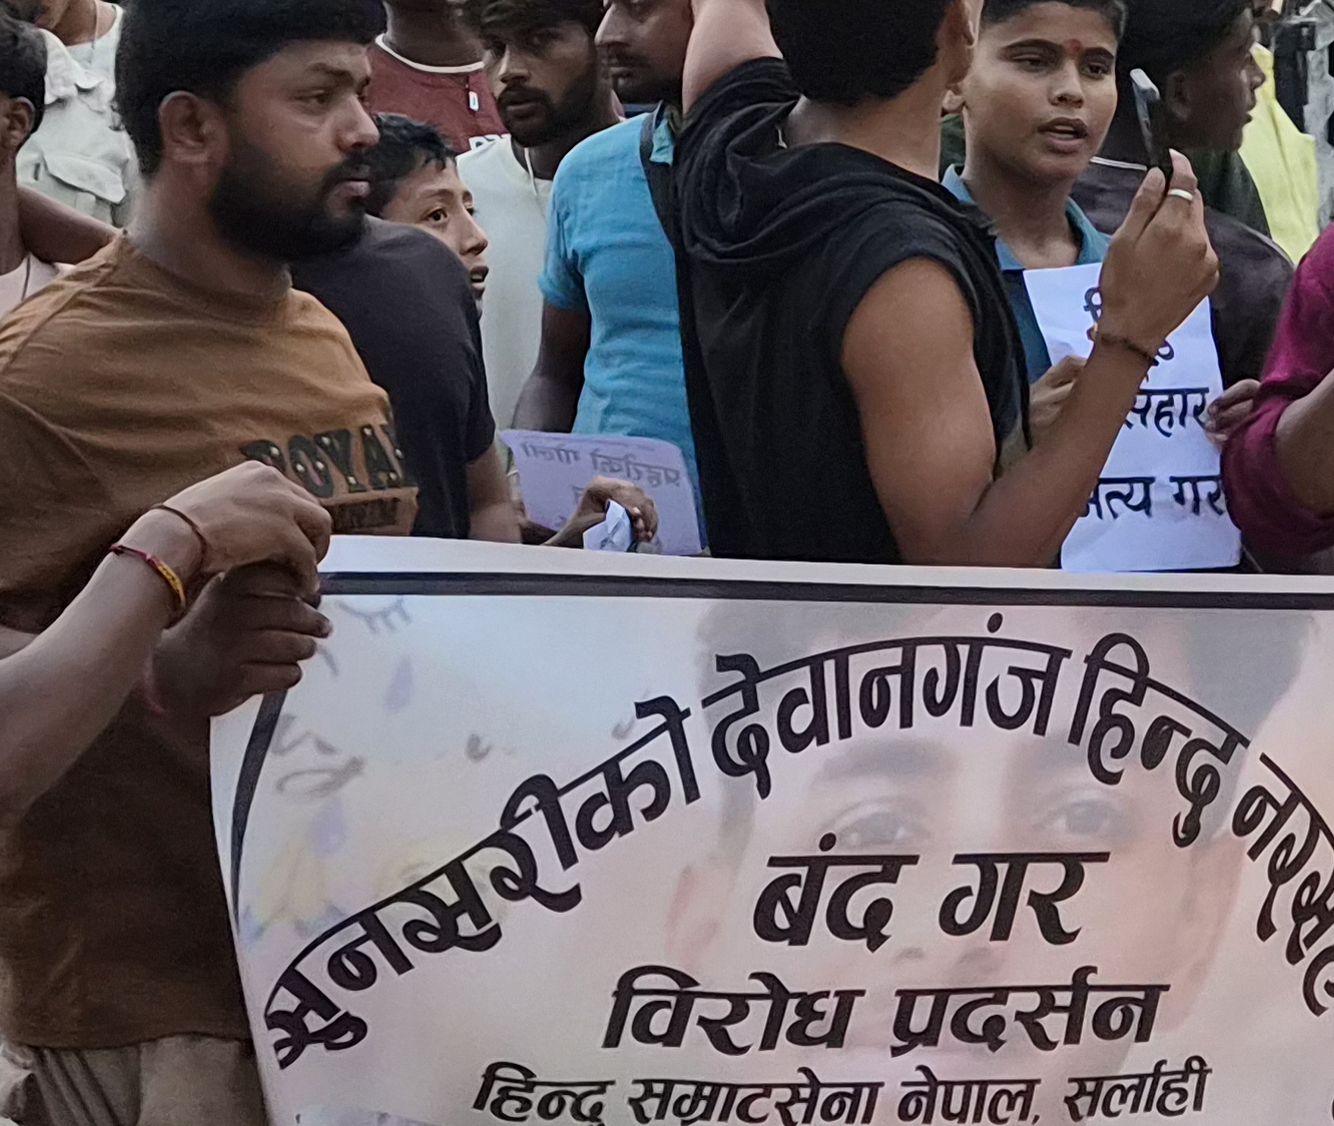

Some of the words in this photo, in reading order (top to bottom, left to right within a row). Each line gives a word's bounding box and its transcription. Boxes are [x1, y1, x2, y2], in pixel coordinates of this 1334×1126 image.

[701, 612, 1072, 800] देवानगंज
[753, 832, 920, 953] बंद
[938, 851, 1110, 946] गर
[602, 964, 866, 1056] विरोध
[890, 965, 1171, 1058] प्रदर्सन
[1064, 1055, 1213, 1123] सर्लाही
